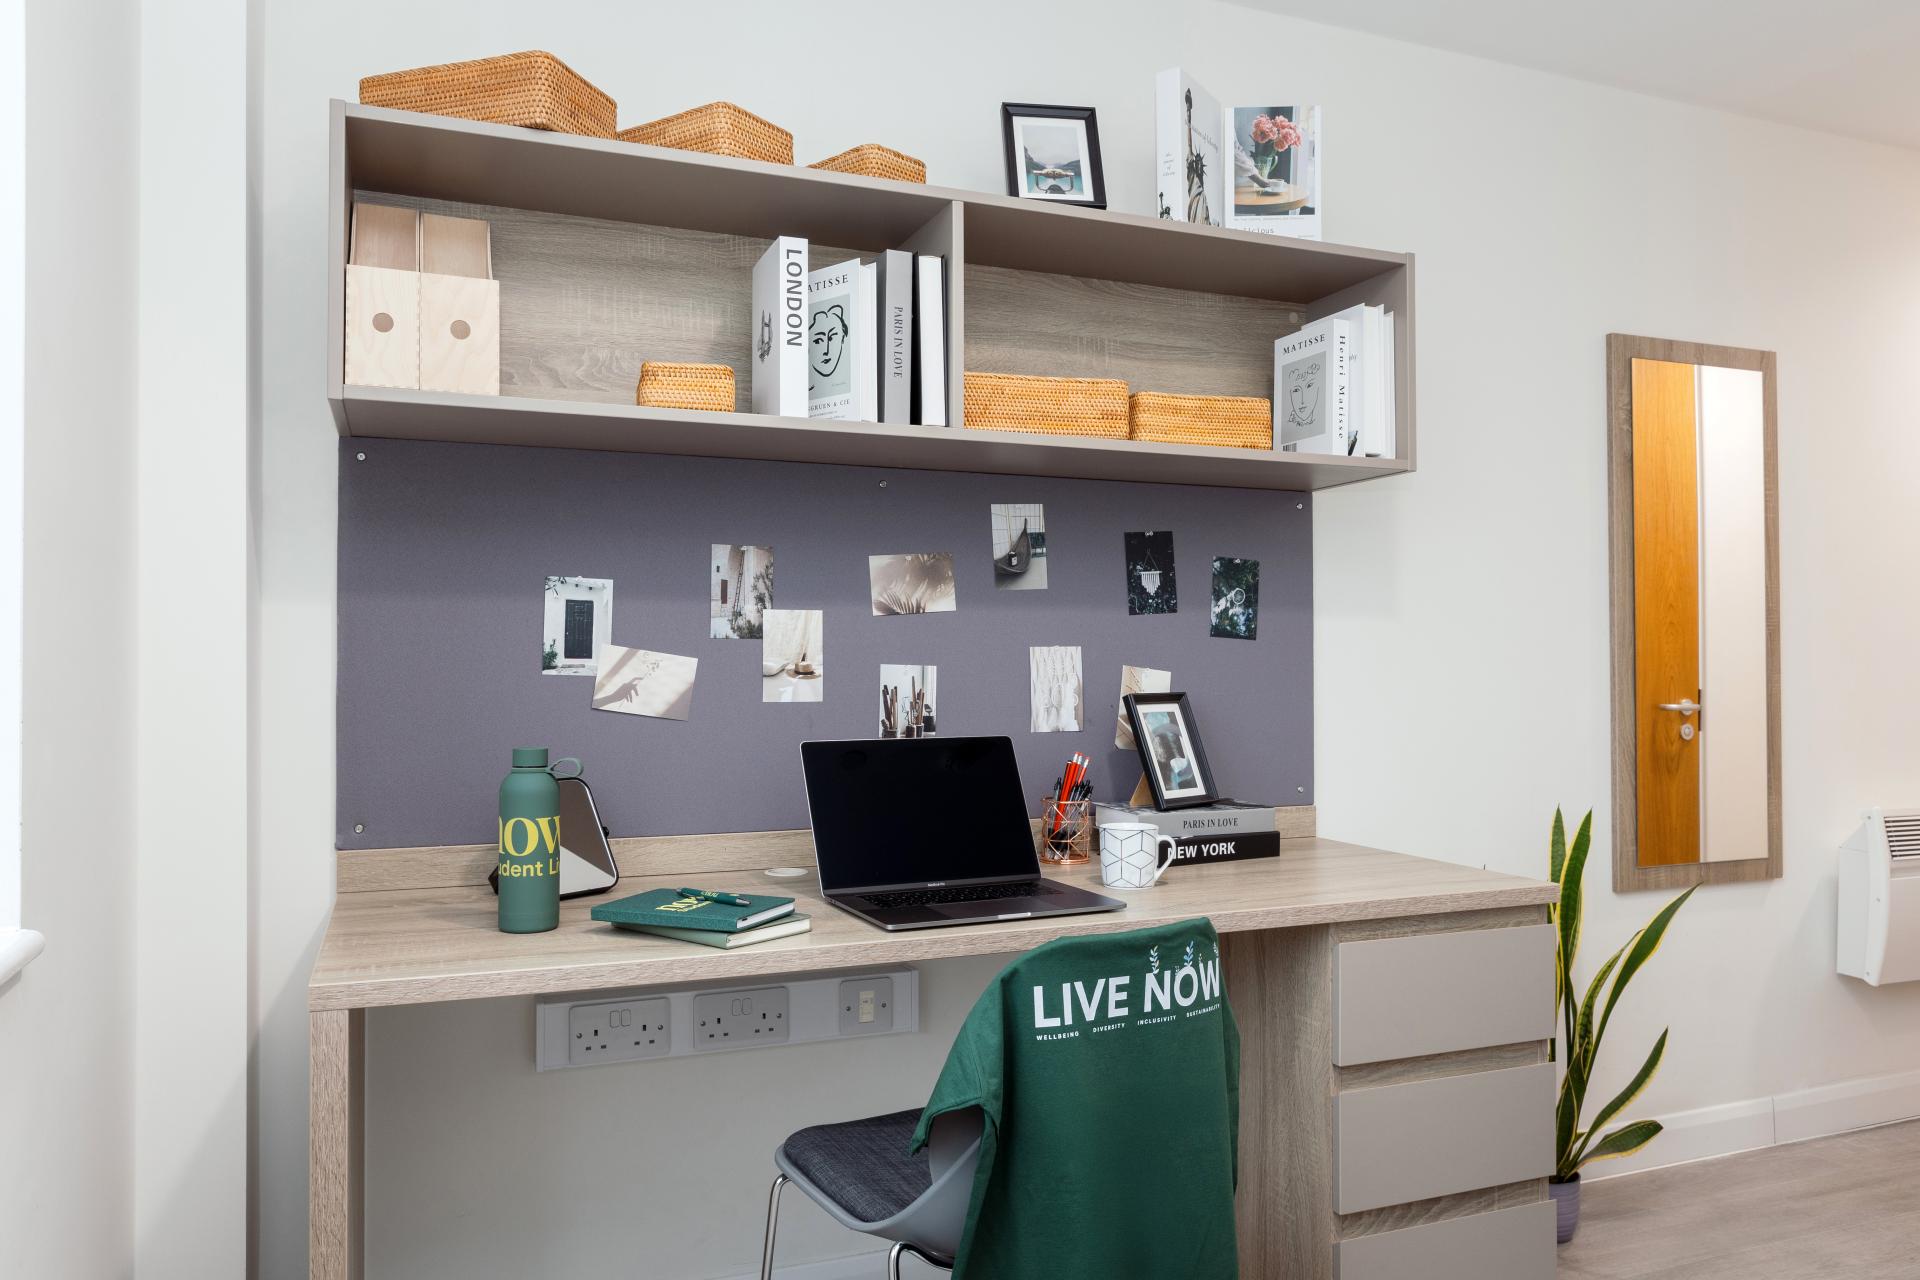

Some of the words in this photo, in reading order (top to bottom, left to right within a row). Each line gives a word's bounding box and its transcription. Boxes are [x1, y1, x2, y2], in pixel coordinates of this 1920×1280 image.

[786, 248, 803, 347] LONDON
[894, 306, 904, 335] PARIS
[893, 337, 903, 348] IN
[1282, 333, 1326, 355] MATISSE
[893, 351, 903, 378] LOVE
[1183, 819, 1205, 829] PARIS
[1206, 818, 1216, 828] IN
[1217, 817, 1239, 827] LOVE
[1167, 845, 1198, 860] NEW
[1201, 842, 1236, 857] YORK
[1033, 975, 1130, 1028] LIVE
[1143, 958, 1220, 1013] NOW
[1036, 1031, 1080, 1041] WELLBEING
[1092, 1022, 1126, 1033] DIVERSITY
[1137, 1014, 1177, 1026] INCLUSIVITY
[1186, 1003, 1220, 1018] SUSTAINABILITY
